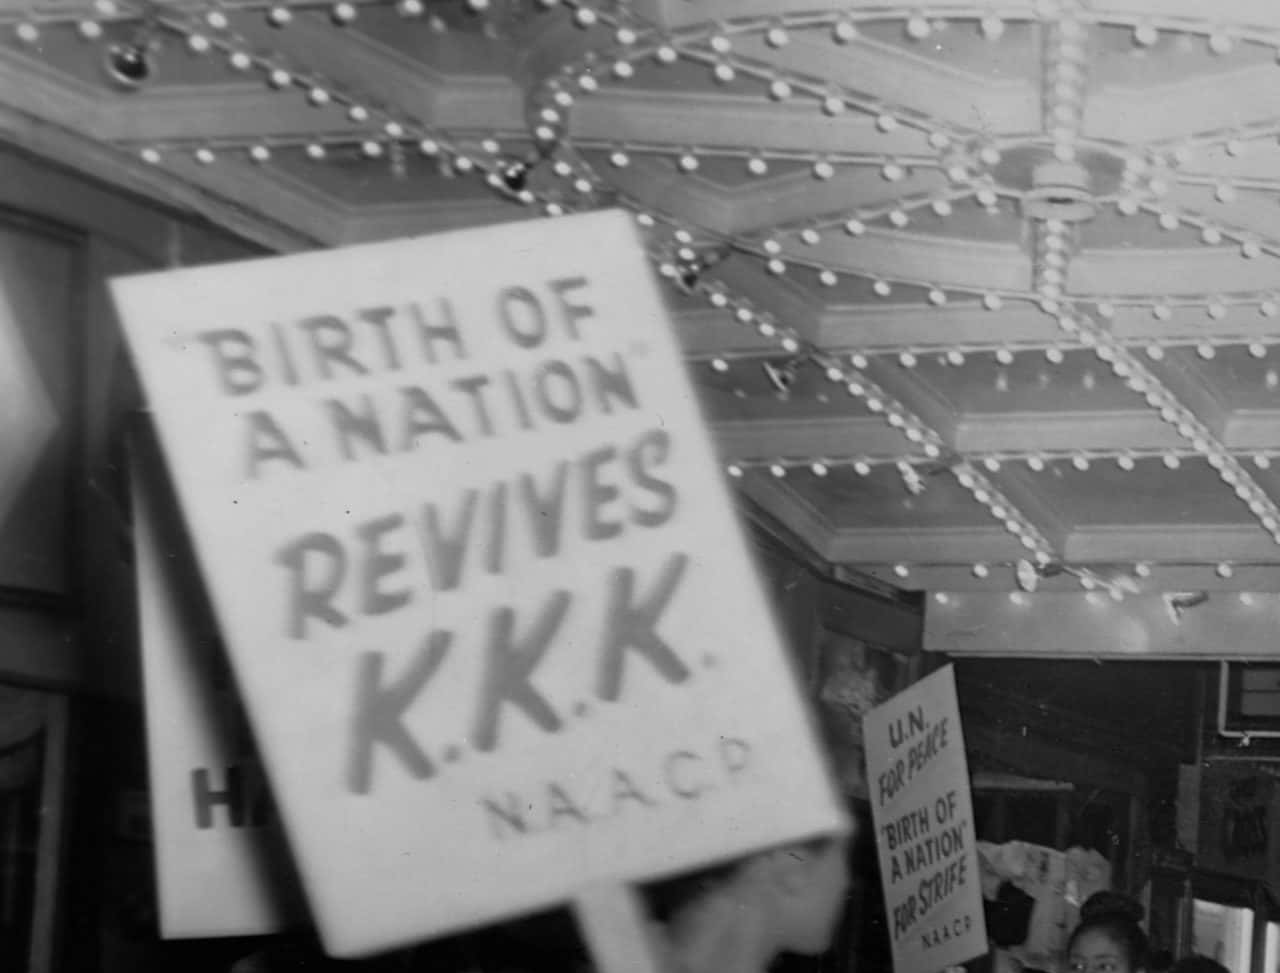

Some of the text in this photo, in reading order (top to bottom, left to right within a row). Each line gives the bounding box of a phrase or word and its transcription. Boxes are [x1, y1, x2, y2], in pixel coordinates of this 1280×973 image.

[495, 275, 599, 350] OF
[243, 408, 308, 480] A
[273, 428, 679, 641] REVIVES
[878, 717, 949, 807] FOR PEACE
[935, 790, 957, 824] OF
[891, 855, 904, 885] A
[893, 855, 968, 940] FOR STRIFE
